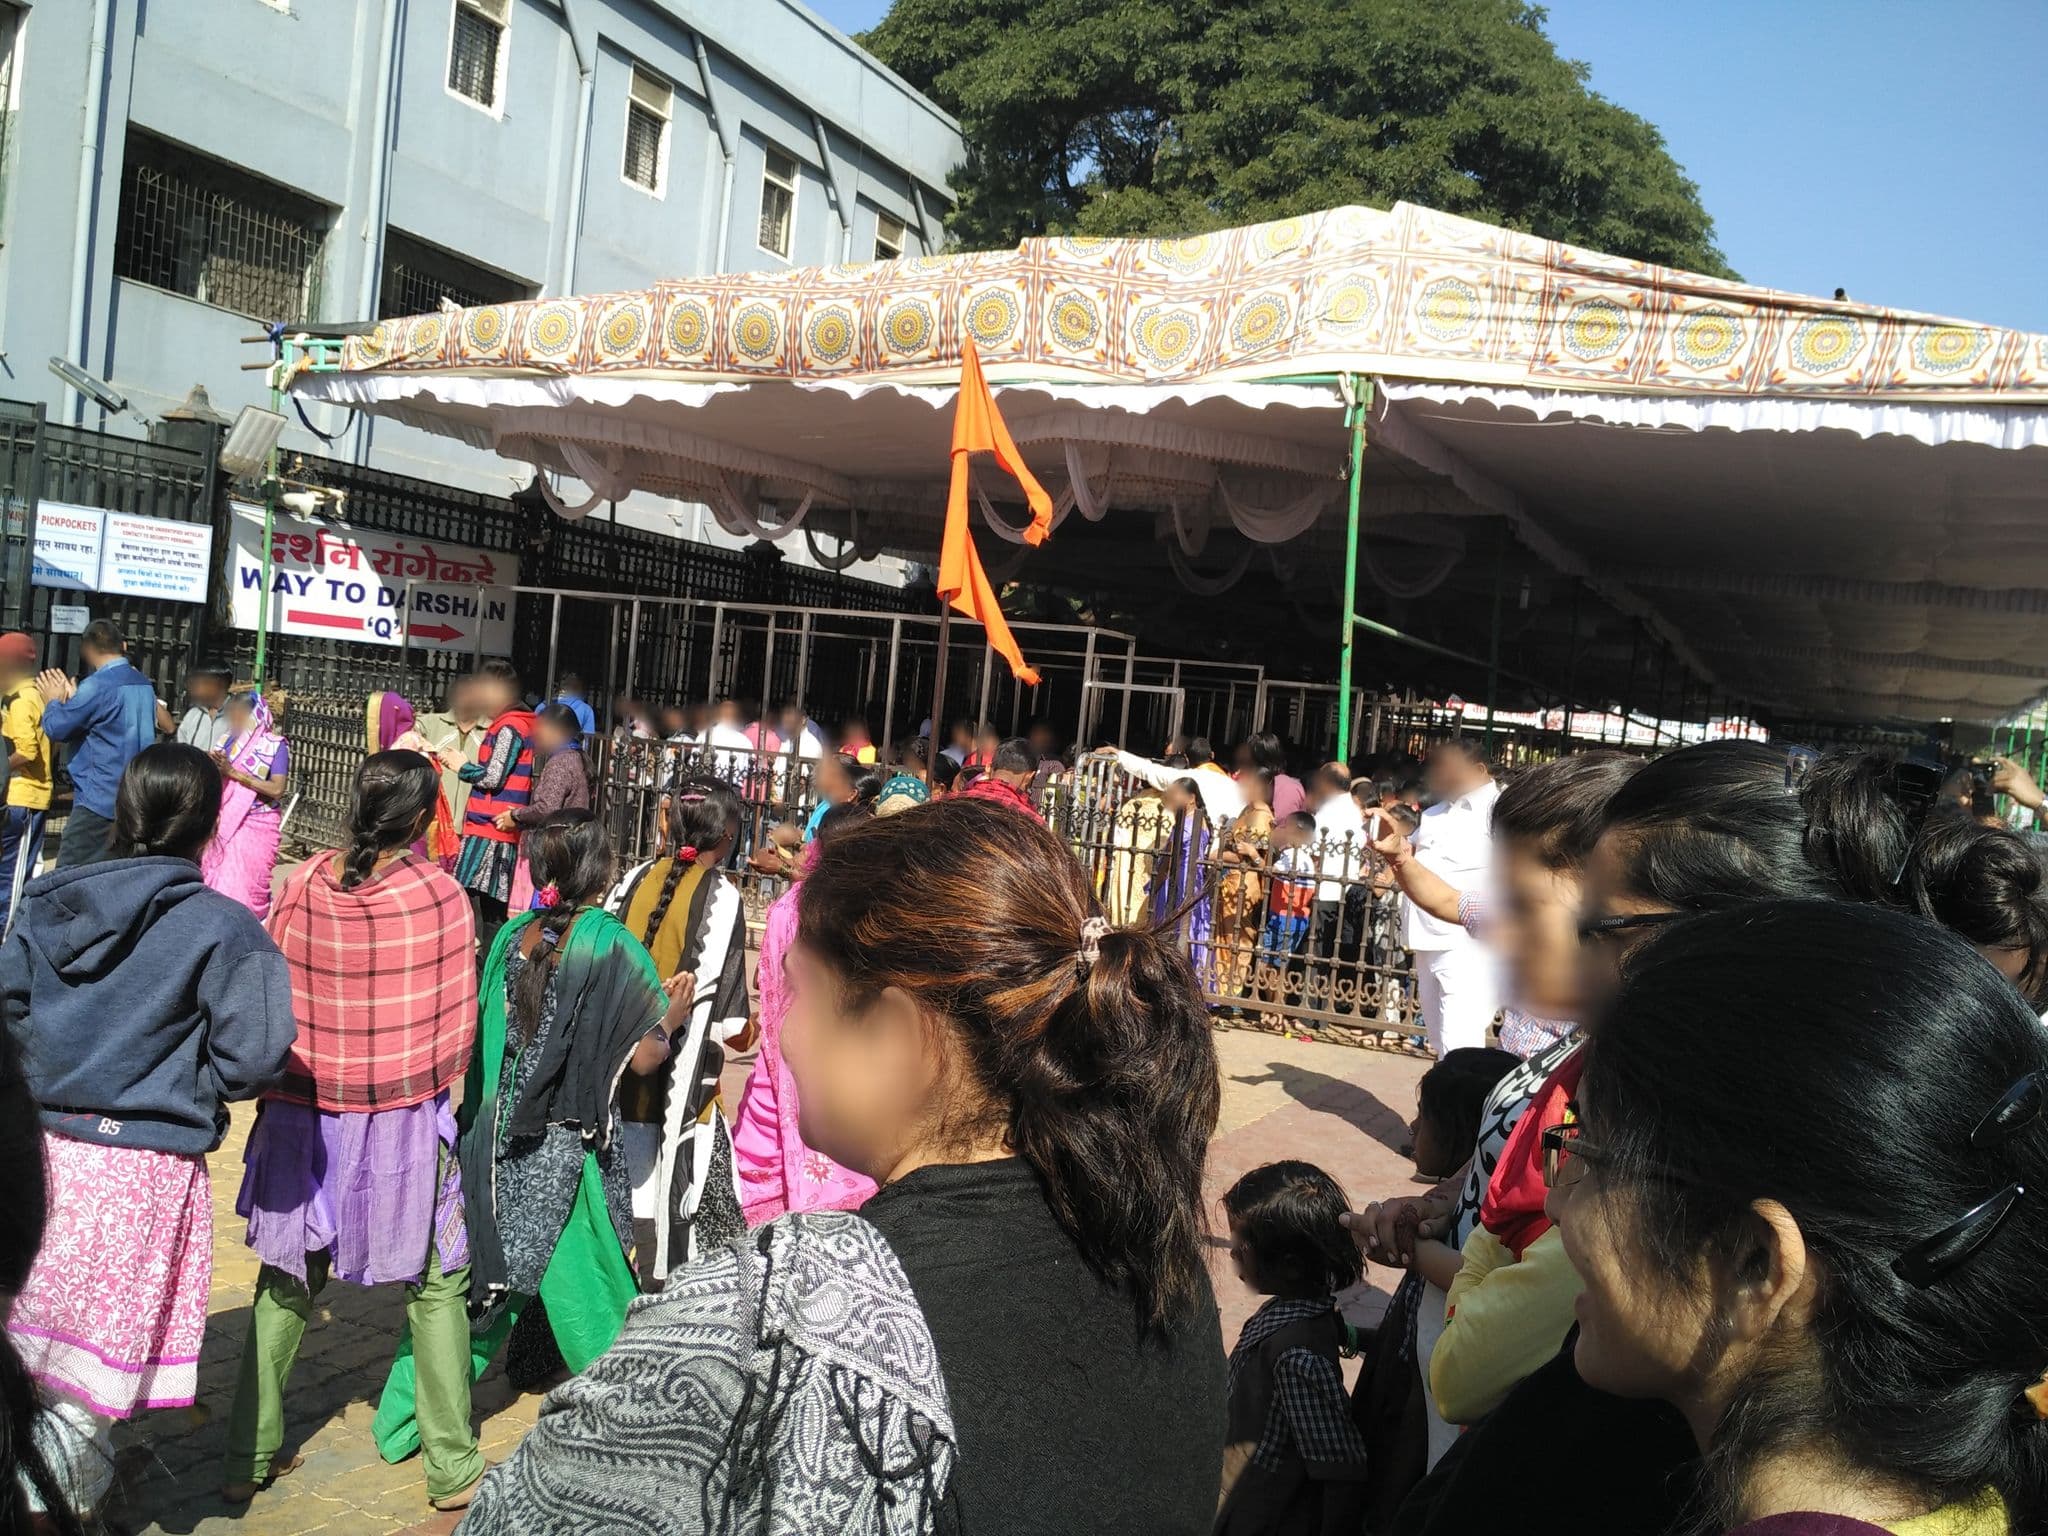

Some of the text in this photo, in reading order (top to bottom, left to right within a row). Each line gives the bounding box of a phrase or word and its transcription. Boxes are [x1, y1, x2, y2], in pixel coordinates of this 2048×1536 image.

[41, 515, 97, 532] PICKPOCKETS
[241, 566, 506, 621] WAY TO DARSHAN
[98, 1117, 123, 1135] 85
